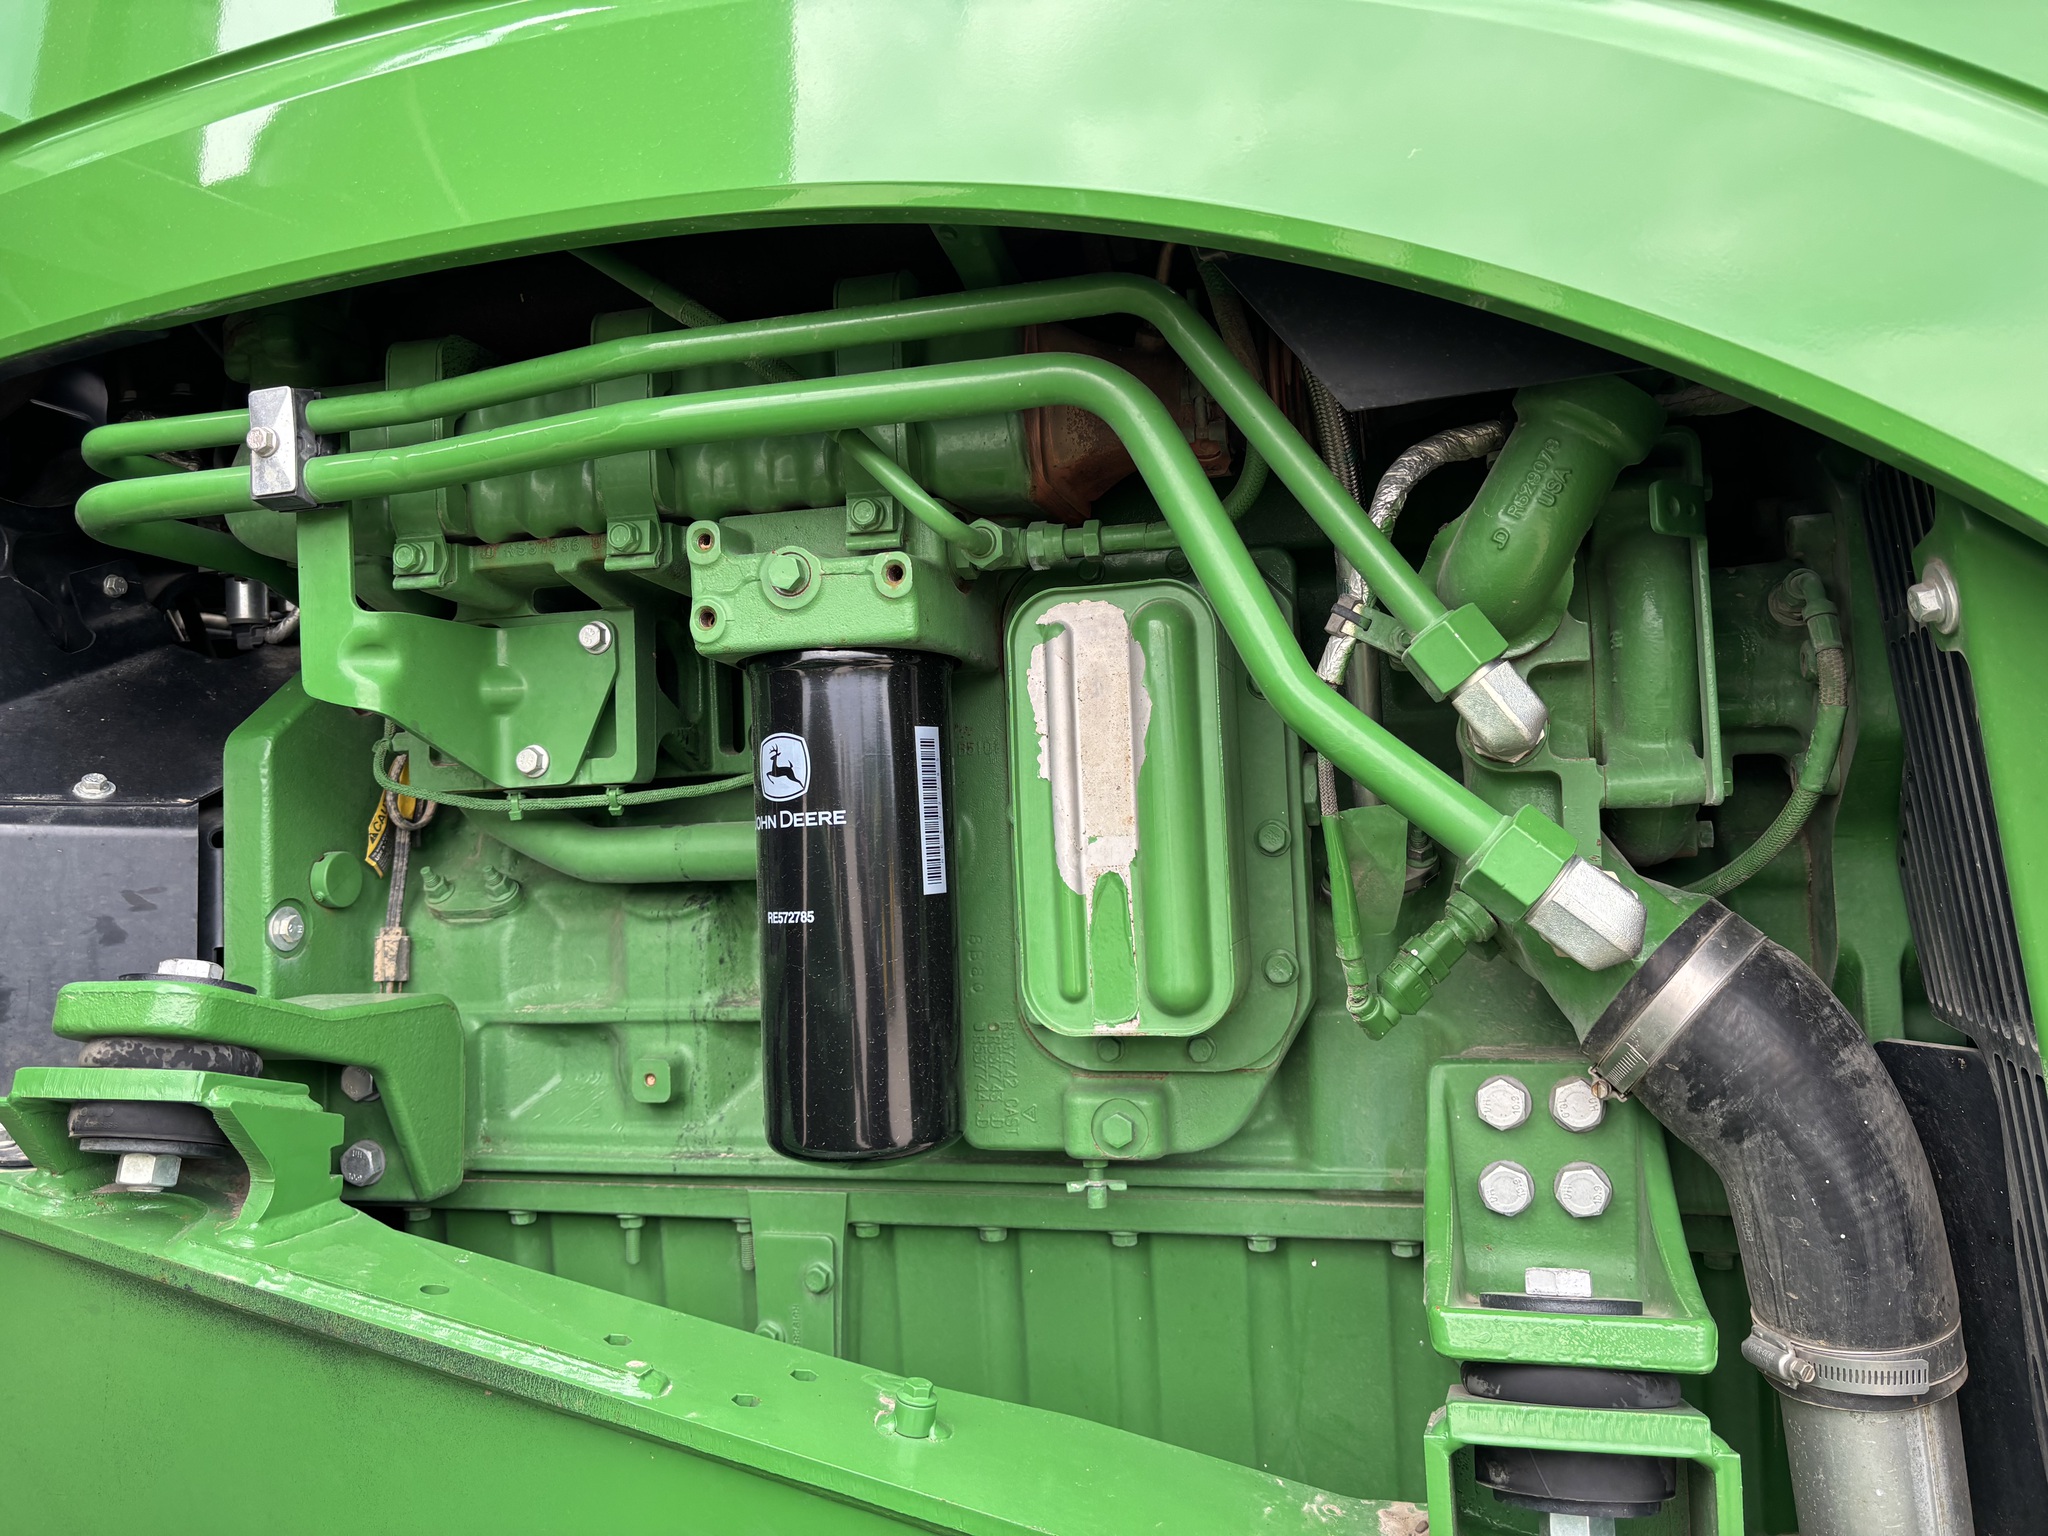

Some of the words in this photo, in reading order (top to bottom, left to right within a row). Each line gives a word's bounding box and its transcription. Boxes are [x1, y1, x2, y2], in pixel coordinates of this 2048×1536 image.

[1537, 467, 1573, 508] USA
[755, 814, 777, 831] OHN
[780, 809, 847, 829] DEERE
[767, 910, 815, 924] RE572785
[1004, 1097, 1020, 1137] CAST
